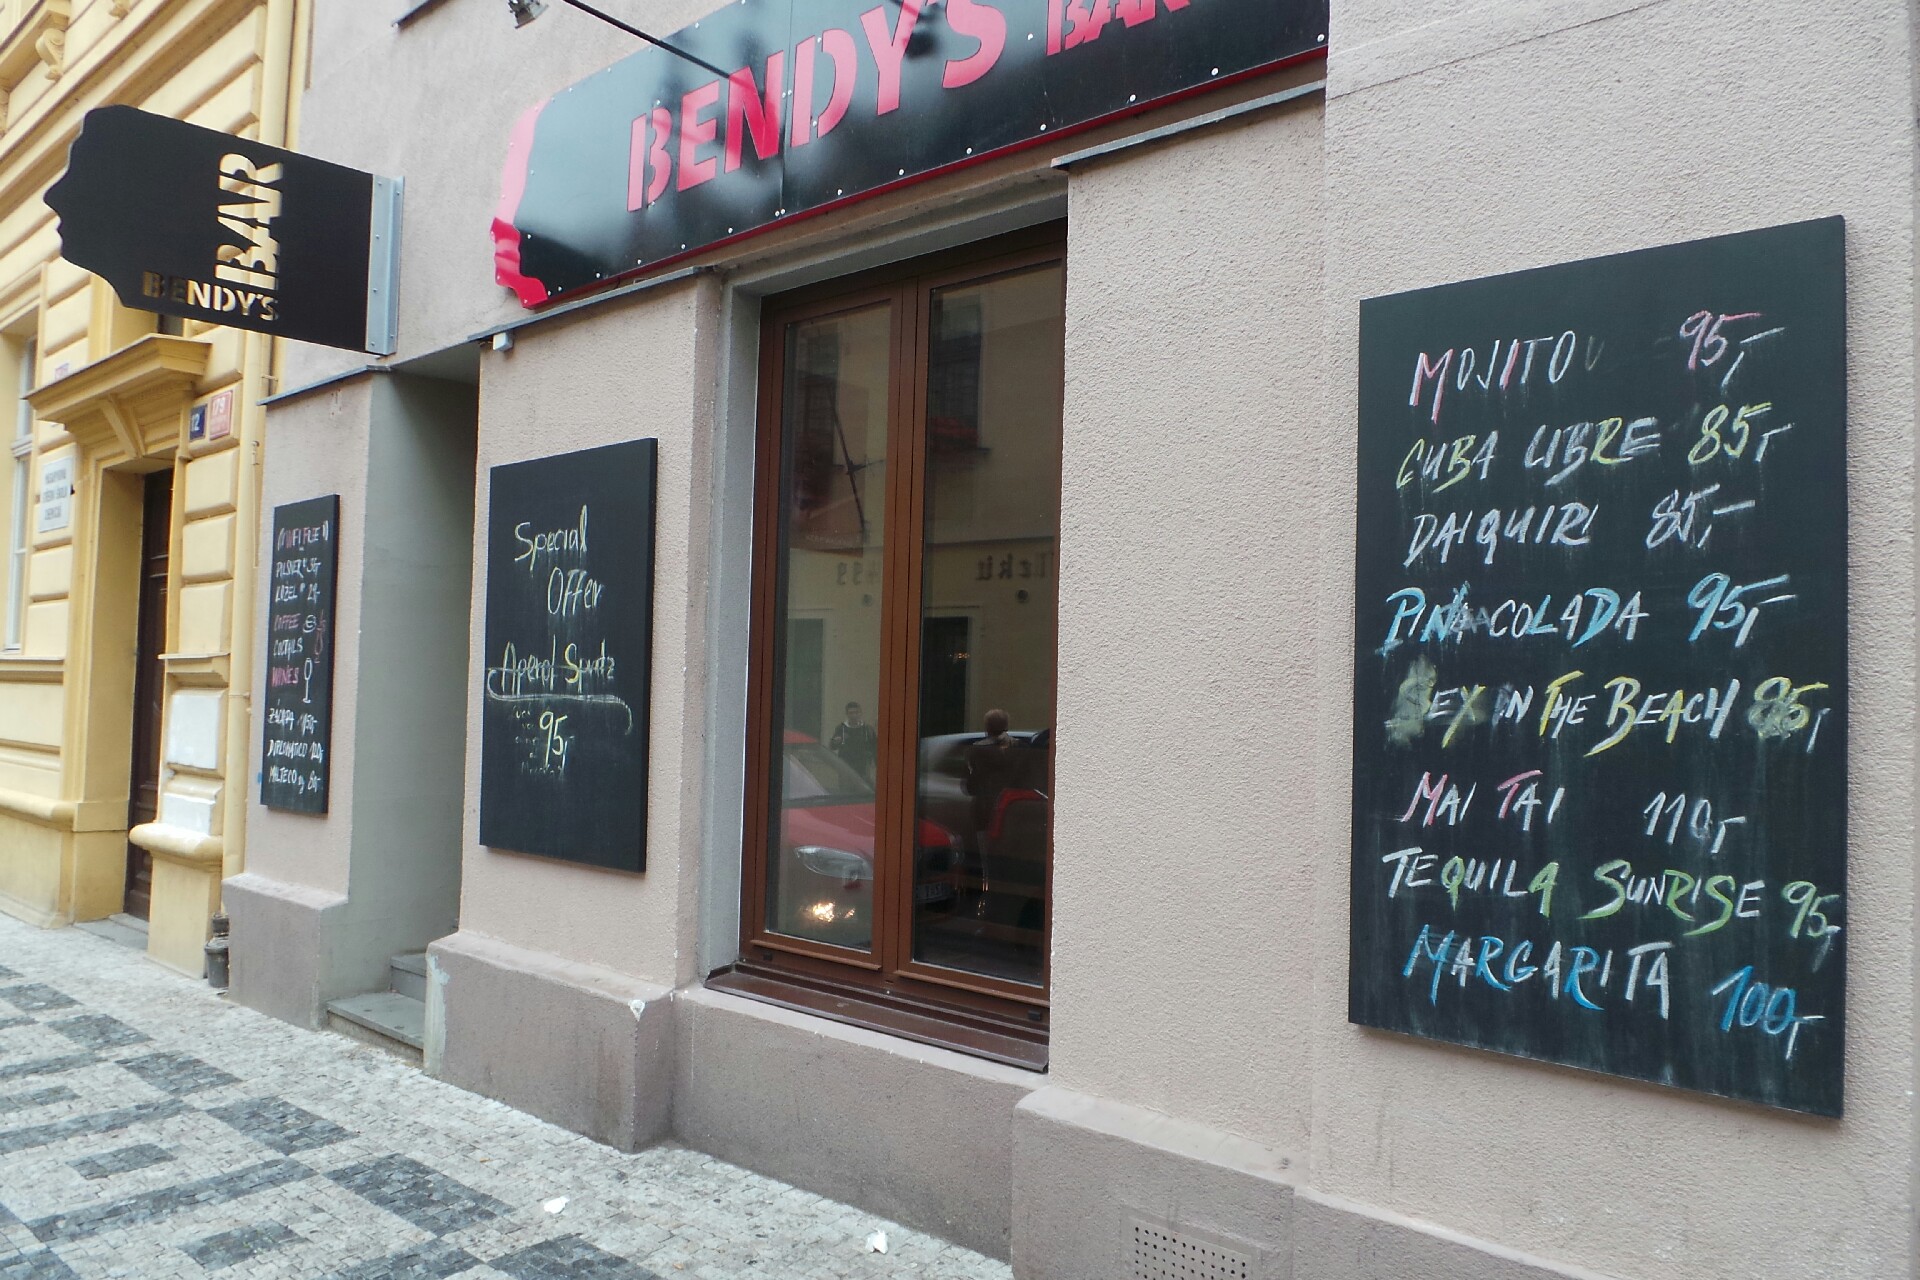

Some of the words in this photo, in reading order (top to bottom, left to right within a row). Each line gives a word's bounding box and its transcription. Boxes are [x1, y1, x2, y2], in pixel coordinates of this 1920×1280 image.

[627, 0, 1007, 212] BENDYS
[215, 153, 284, 291] BAR
[142, 271, 279, 321] BENDY'S
[1409, 331, 1576, 424] MOJITO
[1396, 430, 1500, 493] CUBA
[1524, 417, 1661, 487] LIBRE
[514, 504, 588, 571] Special
[1489, 588, 1650, 648] COLADA
[1540, 671, 1596, 739] THE
[1584, 676, 1741, 758] BEACH
[1401, 771, 1476, 827] MAI
[1497, 769, 1565, 831] TAI
[1382, 847, 1560, 917] TEQUILA
[1577, 858, 1766, 936] SUNRISE
[1403, 924, 1676, 1020] MARGARITA
